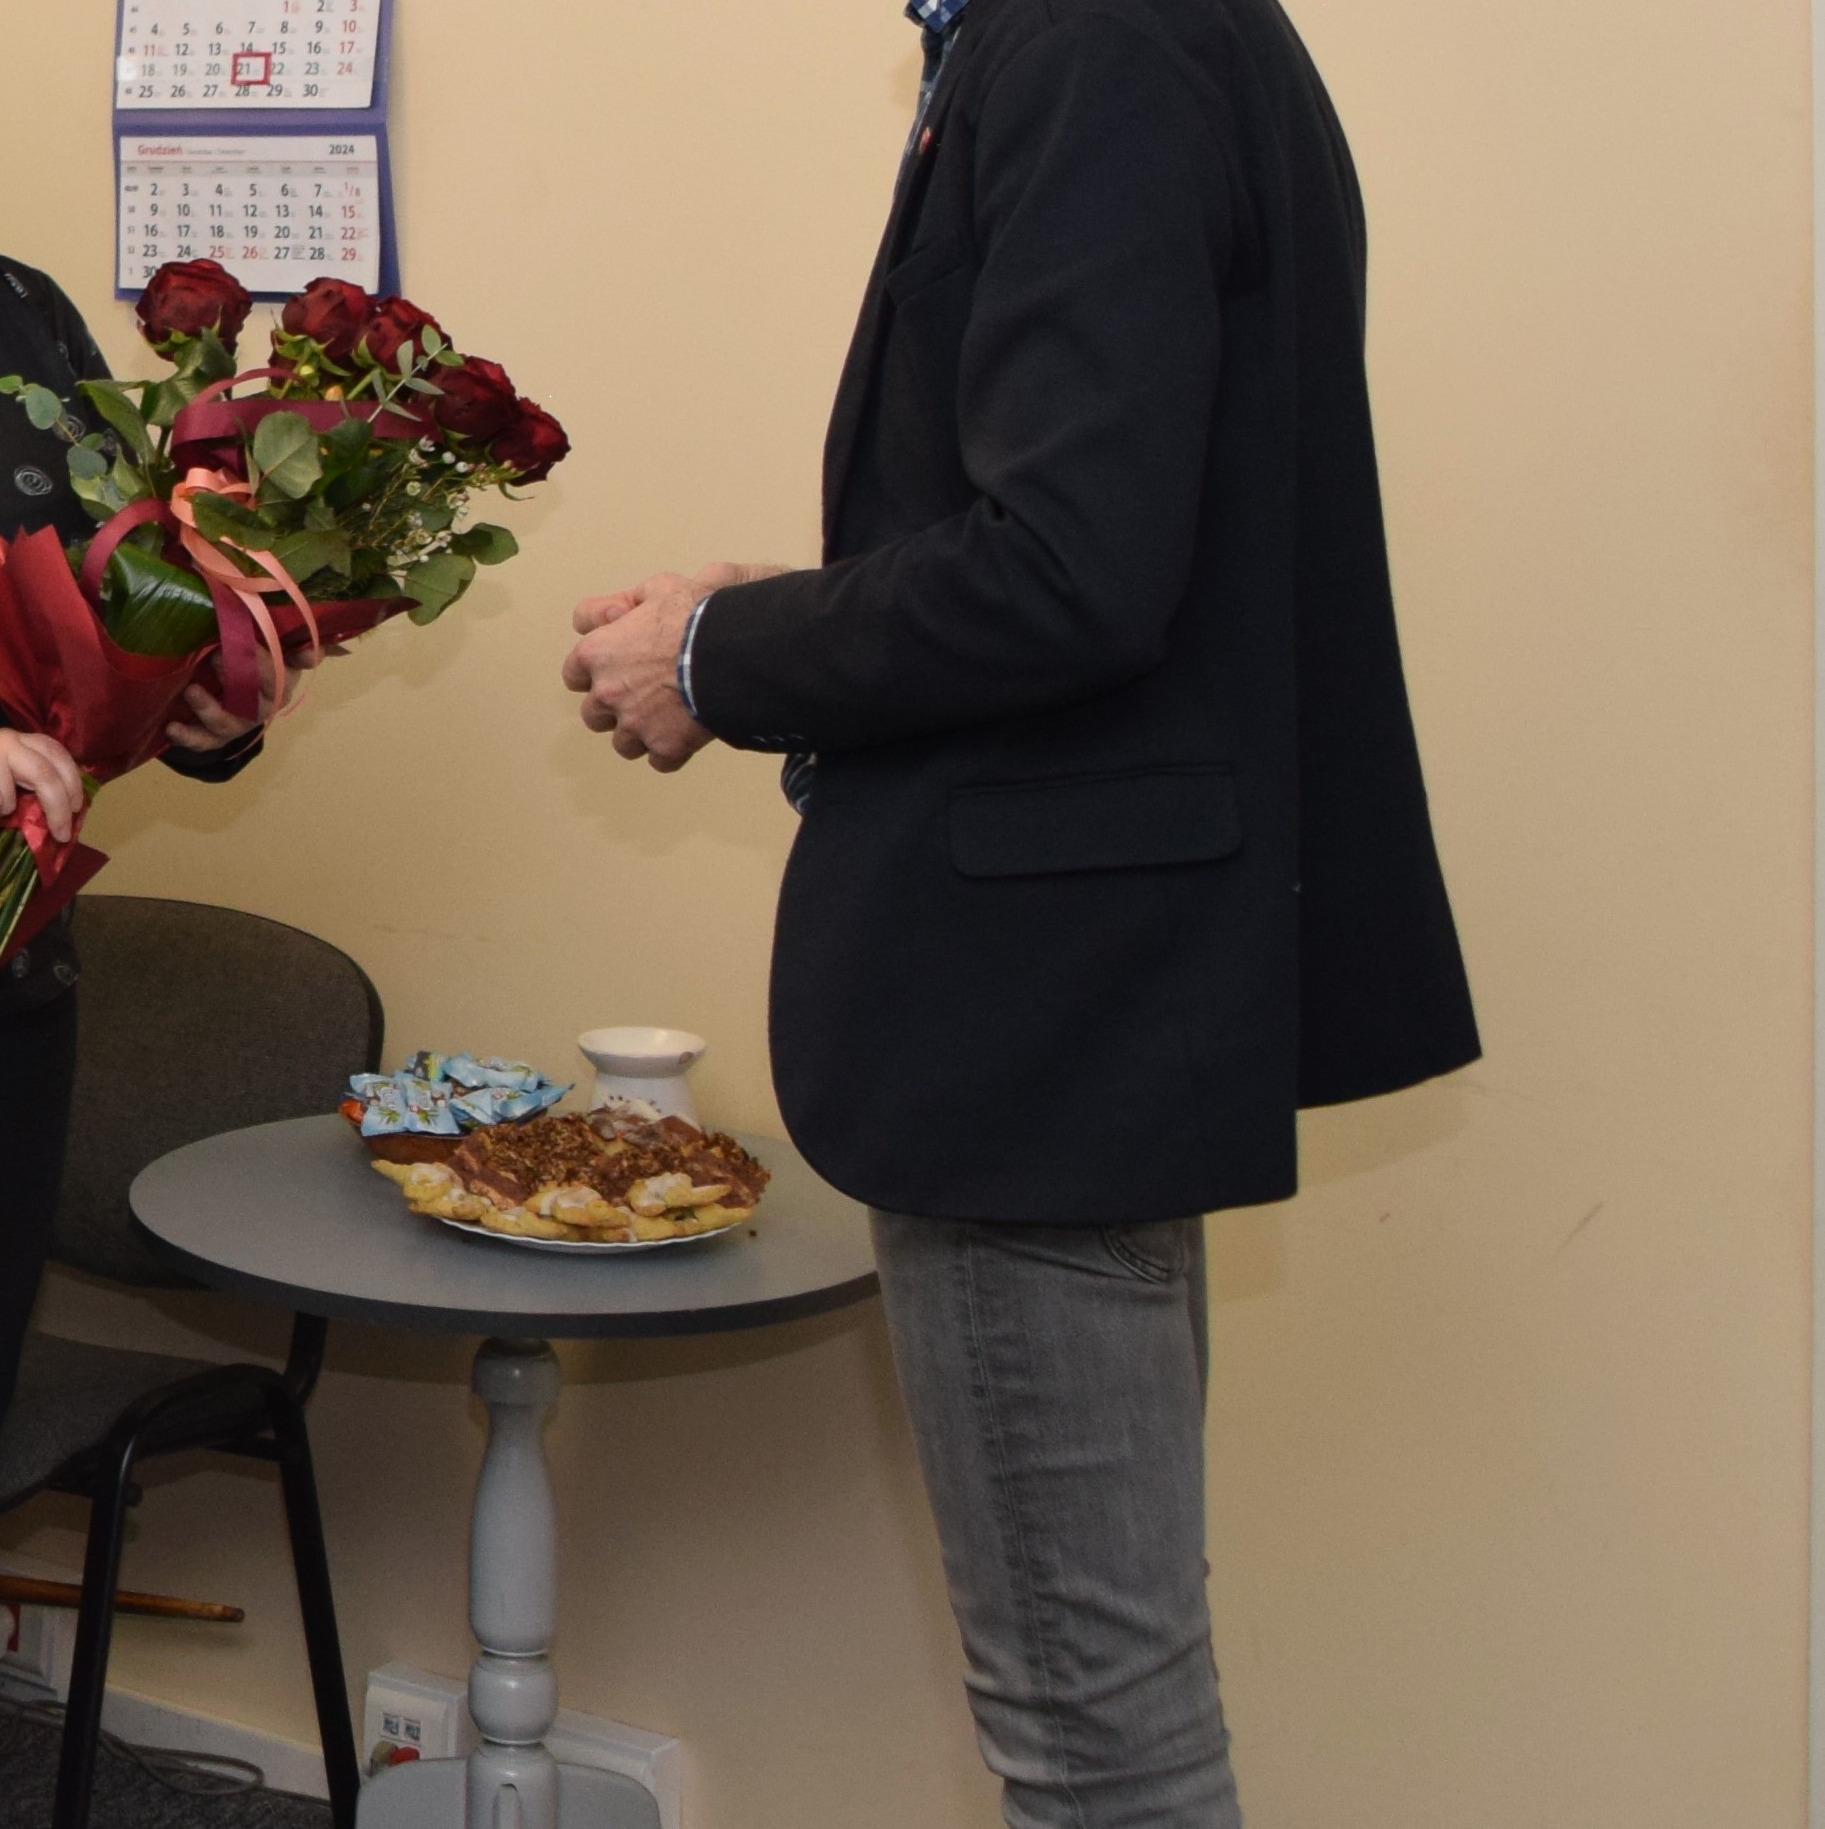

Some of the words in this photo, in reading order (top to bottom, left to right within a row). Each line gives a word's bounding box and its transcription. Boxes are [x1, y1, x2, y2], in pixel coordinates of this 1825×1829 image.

[283, 1, 289, 12] 1
[317, 0, 325, 12] 2
[351, 0, 358, 11] 3
[151, 24, 158, 35] 4
[183, 24, 189, 35] 5
[216, 22, 223, 34] 6
[248, 22, 255, 33] 7
[281, 22, 288, 34] 8
[315, 21, 323, 33] 9
[342, 20, 356, 32] 10
[143, 44, 156, 55] 11
[176, 44, 188, 55] 12
[209, 43, 221, 55] 13
[241, 42, 253, 52] 14
[272, 41, 286, 54] 15
[307, 42, 321, 54] 16
[339, 41, 354, 53] 17
[142, 64, 154, 76] 18
[173, 64, 186, 76] 19
[205, 64, 220, 76] 20
[237, 62, 250, 75] 21
[271, 62, 284, 75] 22
[305, 63, 319, 75] 23
[337, 62, 352, 75] 24
[139, 85, 153, 97] 25
[171, 85, 185, 97] 26
[203, 85, 218, 97] 27
[266, 83, 283, 97] 29
[303, 84, 318, 97] 30
[138, 145, 182, 155] Grudzień
[329, 144, 354, 154] 2024
[151, 184, 158, 196] 2
[183, 184, 189, 196] 3
[216, 184, 223, 196] 4
[250, 184, 256, 196] 5
[281, 184, 288, 197] 6
[315, 185, 321, 197] 7
[151, 204, 158, 216] 9
[177, 204, 190, 216] 10
[210, 204, 222, 216] 11
[244, 204, 257, 217] 12
[276, 205, 290, 217] 13
[309, 205, 323, 218] 14
[342, 206, 355, 218] 15
[144, 225, 158, 237] 16
[178, 225, 190, 237] 17
[211, 225, 224, 237] 18
[244, 226, 258, 238] 19
[275, 226, 290, 238] 20
[309, 227, 323, 239] 21
[342, 227, 356, 239] 22
[143, 245, 157, 257] 23
[177, 245, 191, 257] 24
[210, 246, 224, 258] 25
[243, 246, 258, 258] 26
[274, 246, 290, 259] 27
[310, 247, 324, 260] 28
[342, 248, 356, 260] 29
